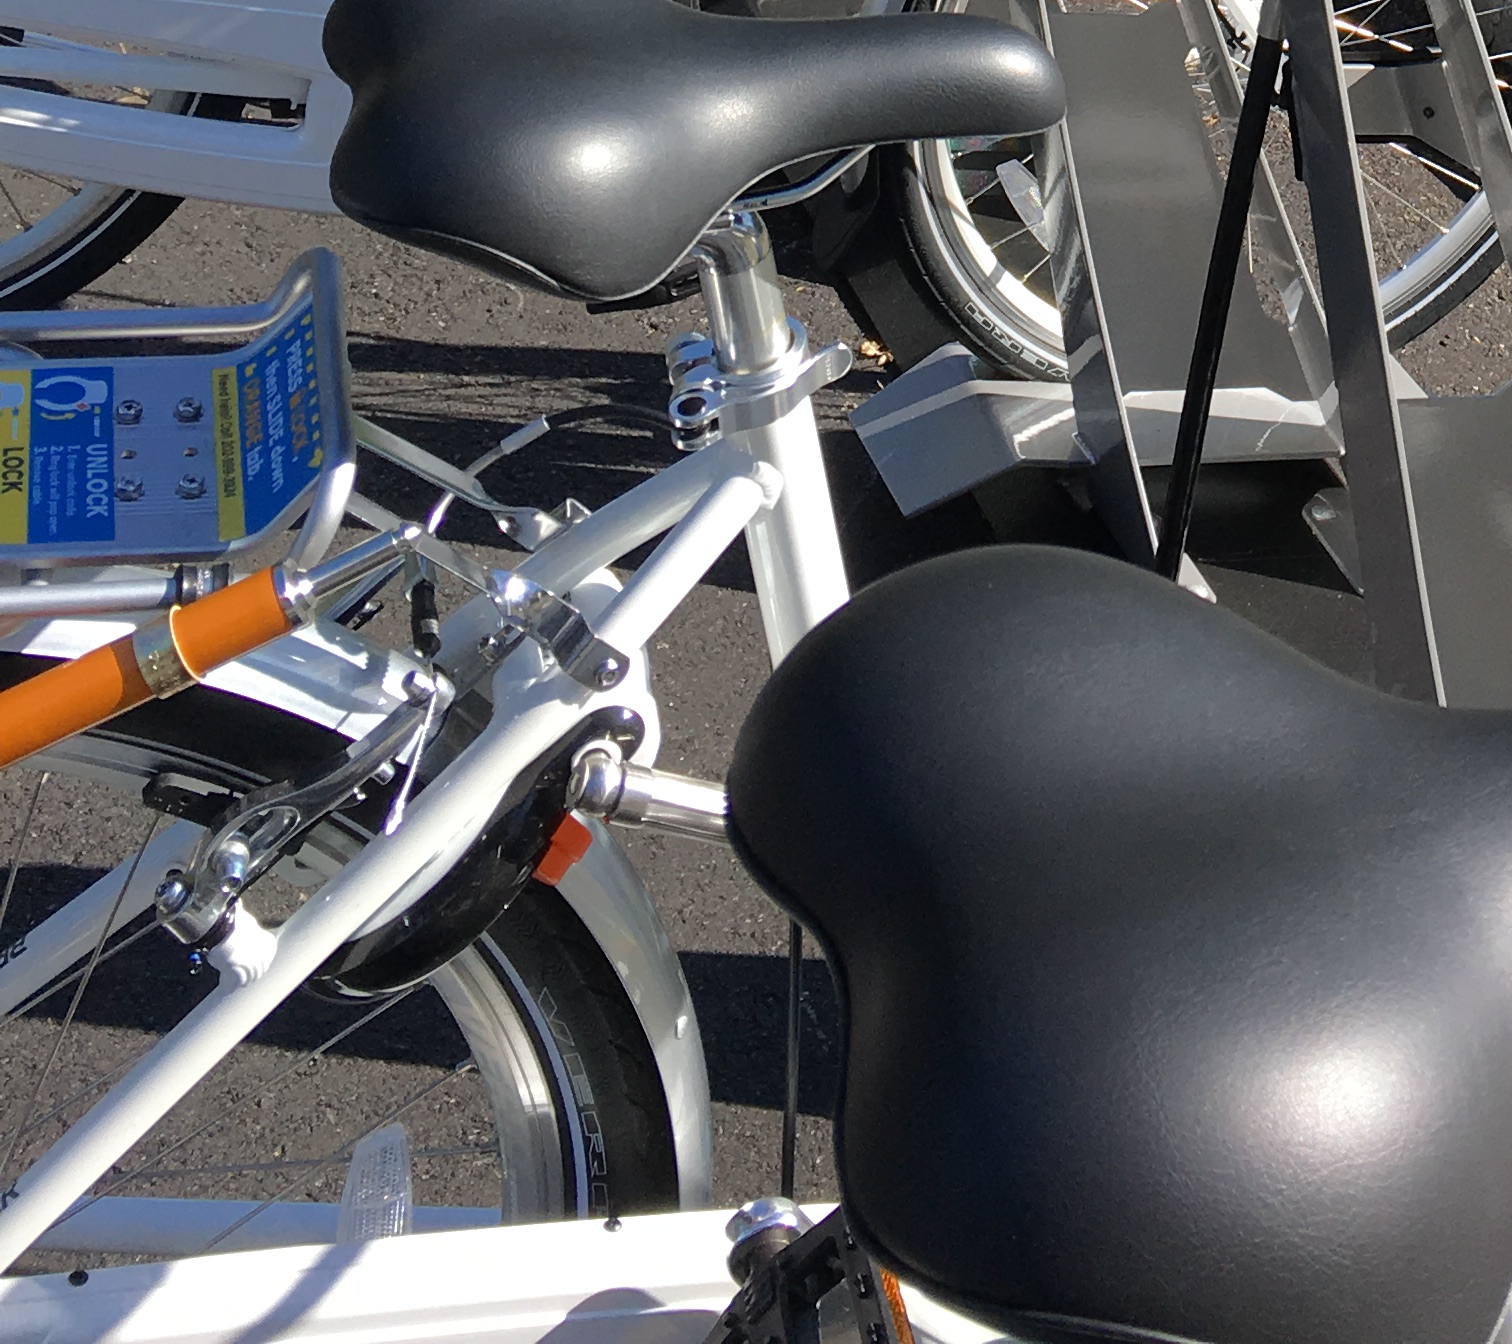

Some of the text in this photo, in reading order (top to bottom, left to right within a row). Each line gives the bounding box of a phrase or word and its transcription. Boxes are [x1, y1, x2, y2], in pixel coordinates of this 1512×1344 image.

[285, 338, 304, 393] PRESS
[266, 394, 284, 448] SLIDE
[1, 446, 25, 495] LOCK
[86, 443, 109, 518] UNLOCK
[271, 445, 286, 494] down
